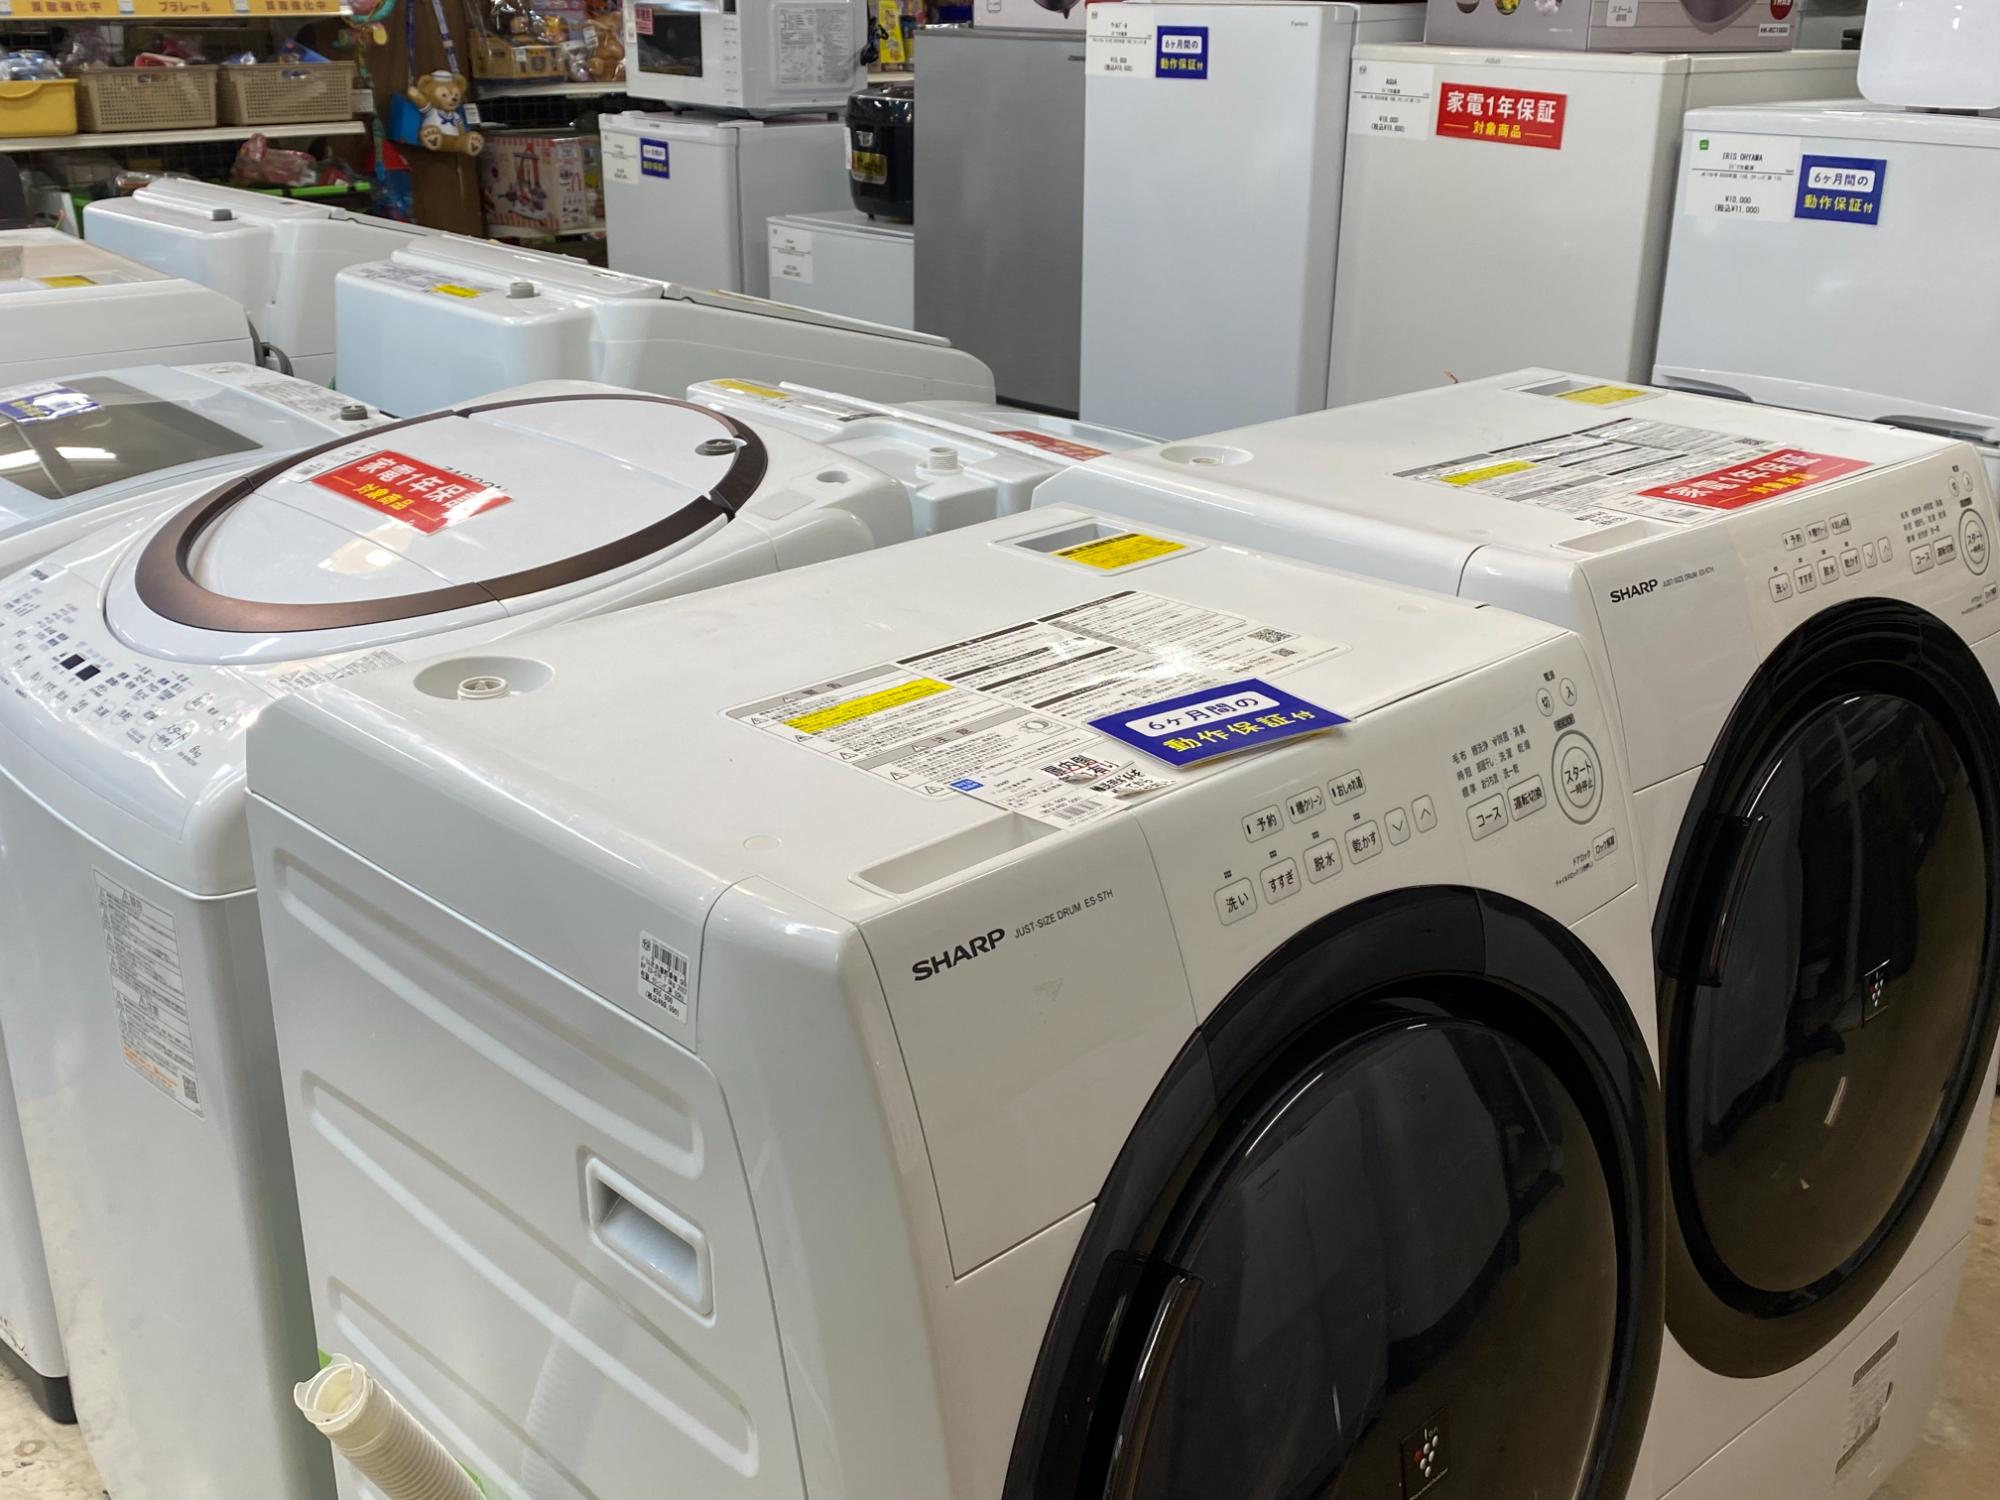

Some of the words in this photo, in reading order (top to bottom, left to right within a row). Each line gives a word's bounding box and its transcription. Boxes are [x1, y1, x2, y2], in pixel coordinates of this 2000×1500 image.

[1447, 90, 1556, 123] 家電1年保証
[1472, 120, 1522, 139] 対象商品
[1722, 152, 1737, 161] IRIS
[1814, 171, 1869, 187] 6ヶ月間の
[1803, 194, 1873, 214] 動作保証付
[353, 482, 415, 511] 対象商品
[1610, 578, 1658, 603] SHARP
[1566, 685, 1574, 698] 入
[1147, 697, 1259, 730] 6ヶ月間の
[1162, 709, 1317, 753] 動作保証付
[1564, 760, 1592, 784] スタート
[1513, 786, 1543, 810] 運転切換
[1569, 779, 1595, 796] 一時停止
[1256, 813, 1278, 832] 予約
[1476, 805, 1502, 828] コース
[1352, 831, 1377, 854] 乾かす
[1313, 851, 1336, 872] 脱水
[1268, 868, 1294, 893] すすぎ
[1225, 892, 1249, 913] 洗い
[912, 928, 1005, 982] SHARP
[1014, 912, 1057, 939] JUST-SIZE
[1056, 902, 1082, 920] DRUM
[1083, 888, 1114, 908] ES-S7H
